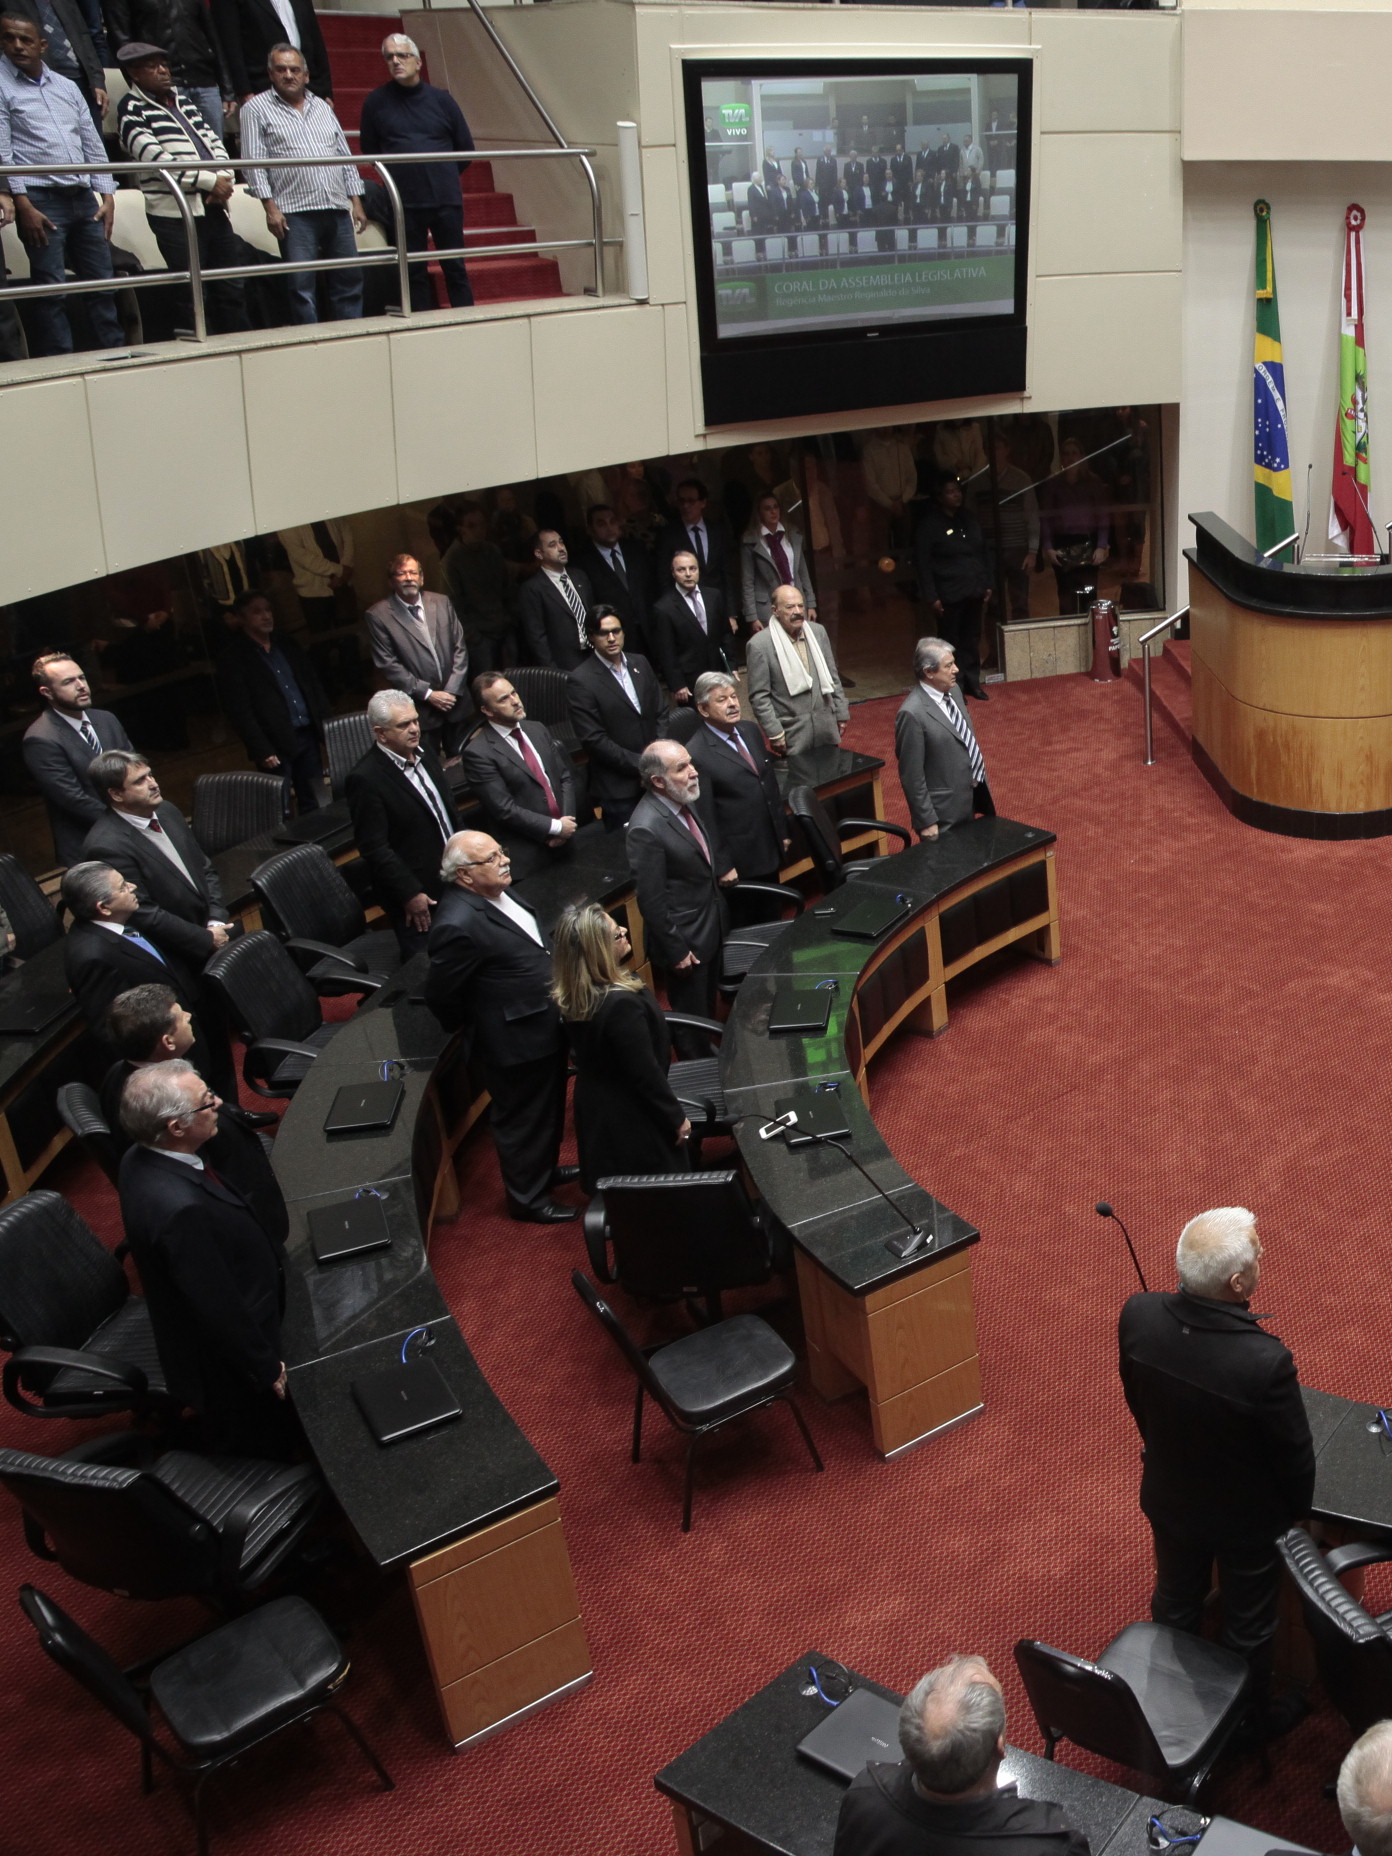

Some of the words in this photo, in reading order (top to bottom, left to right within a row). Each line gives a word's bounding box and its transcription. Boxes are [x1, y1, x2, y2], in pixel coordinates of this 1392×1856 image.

[726, 128, 747, 136] VIVO
[774, 280, 814, 294] CORAL
[819, 277, 837, 291] DA
[840, 271, 913, 289] ASSEMBLEIA
[915, 266, 987, 284] LEGISLATIVA
[818, 292, 853, 303] Maestro
[911, 285, 931, 295] Silva
